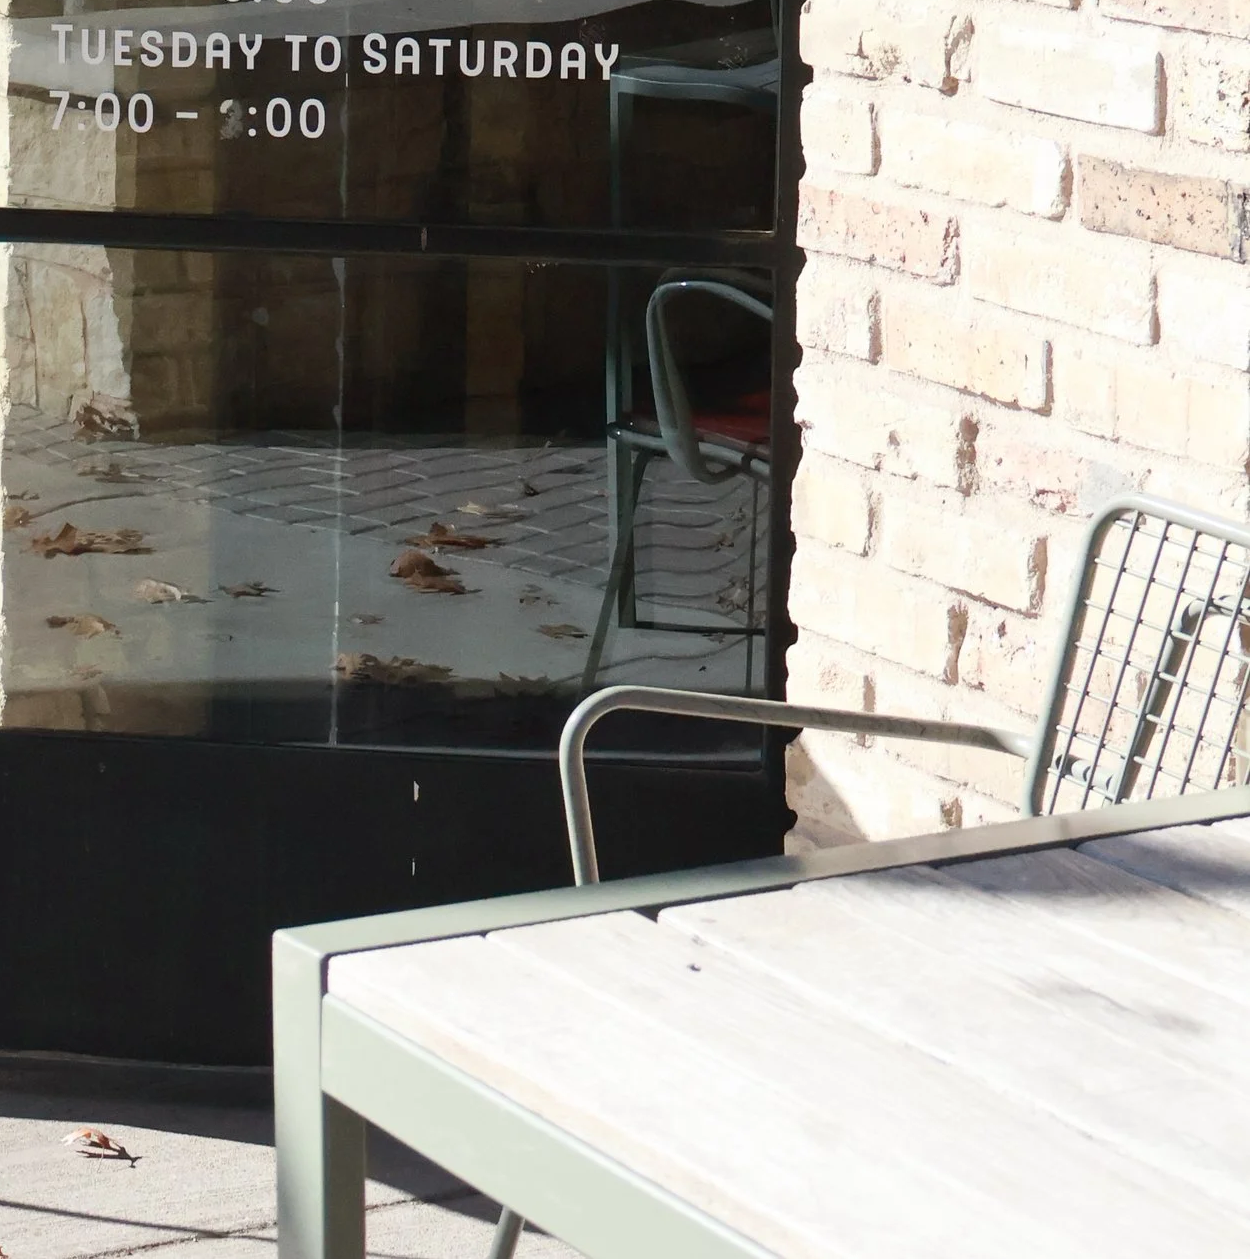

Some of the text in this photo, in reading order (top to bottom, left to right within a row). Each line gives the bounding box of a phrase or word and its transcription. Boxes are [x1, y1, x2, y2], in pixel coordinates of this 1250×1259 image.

[51, 24, 620, 80] TUESDAY TO SATURDAY
[49, 91, 154, 133] 7:00
